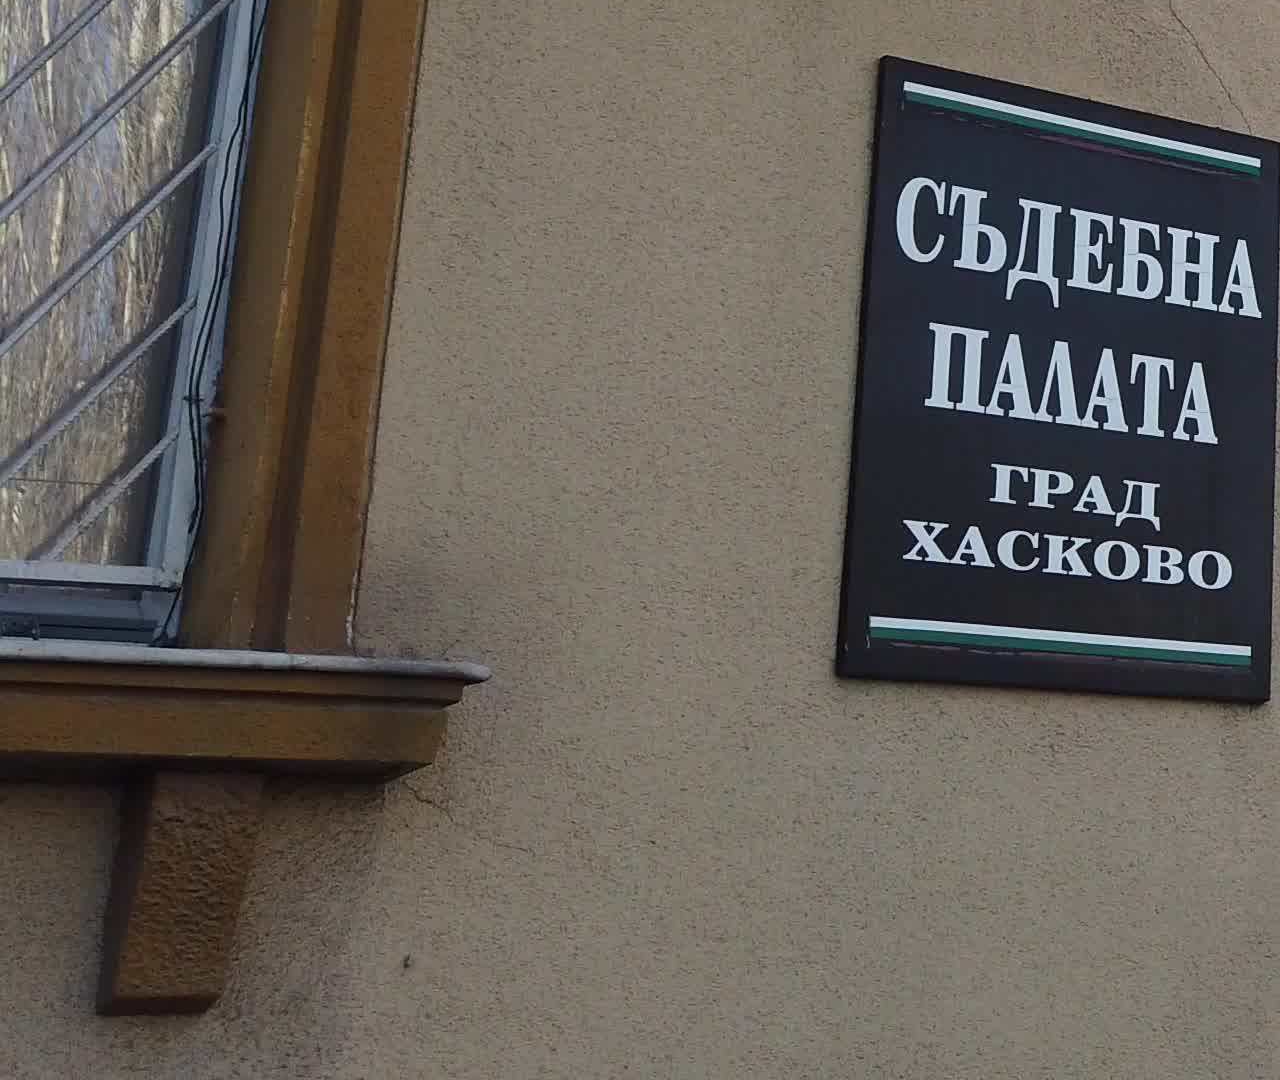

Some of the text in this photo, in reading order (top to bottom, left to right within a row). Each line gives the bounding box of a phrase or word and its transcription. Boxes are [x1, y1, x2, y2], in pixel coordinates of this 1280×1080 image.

[895, 176, 1262, 319] СЪДЕБНА
[924, 321, 1218, 445] ПАЛАТА
[988, 463, 1161, 532] ГРАД
[902, 519, 1233, 590] ХАСКОВО
